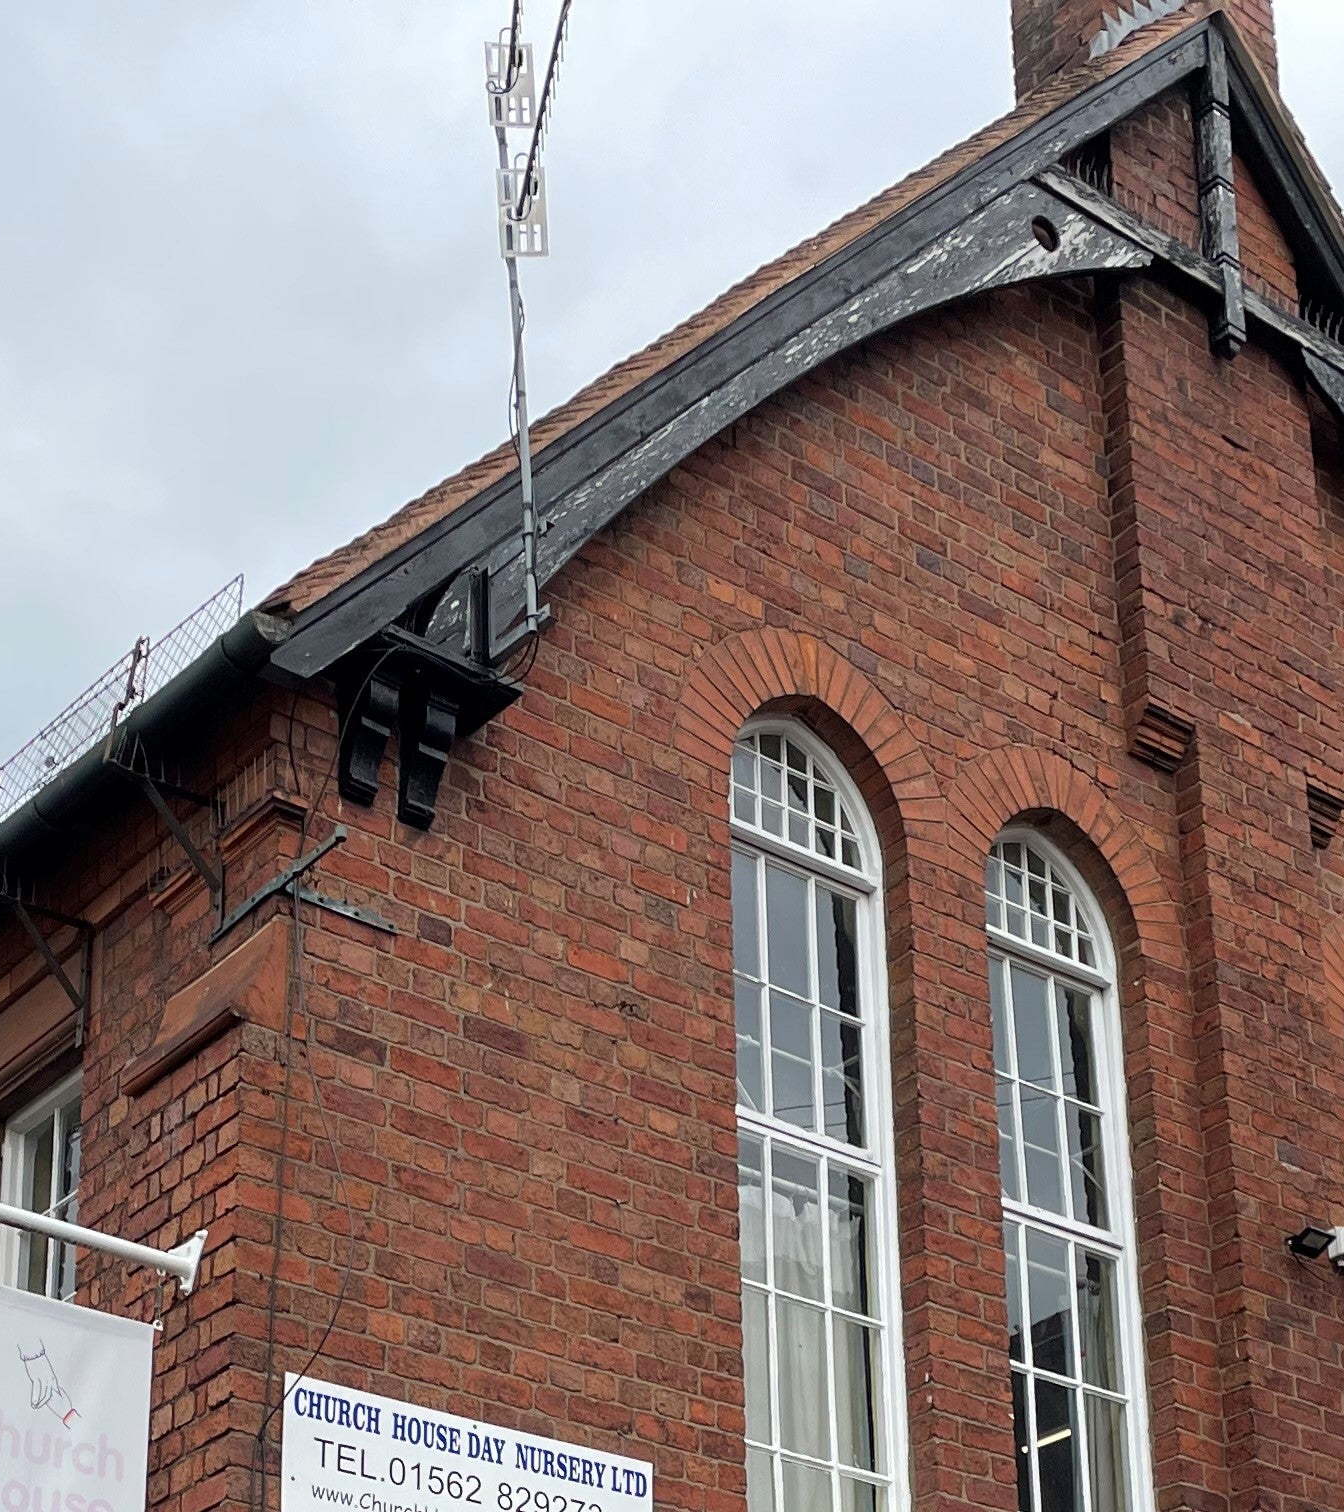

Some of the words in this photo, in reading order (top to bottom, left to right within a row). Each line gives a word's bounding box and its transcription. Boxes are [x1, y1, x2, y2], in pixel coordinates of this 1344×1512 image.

[294, 1387, 381, 1435] CHURCH
[392, 1412, 461, 1455] HOUSE
[467, 1431, 506, 1465] DAY
[515, 1442, 606, 1489] NURSERY
[611, 1465, 648, 1498] LTD
